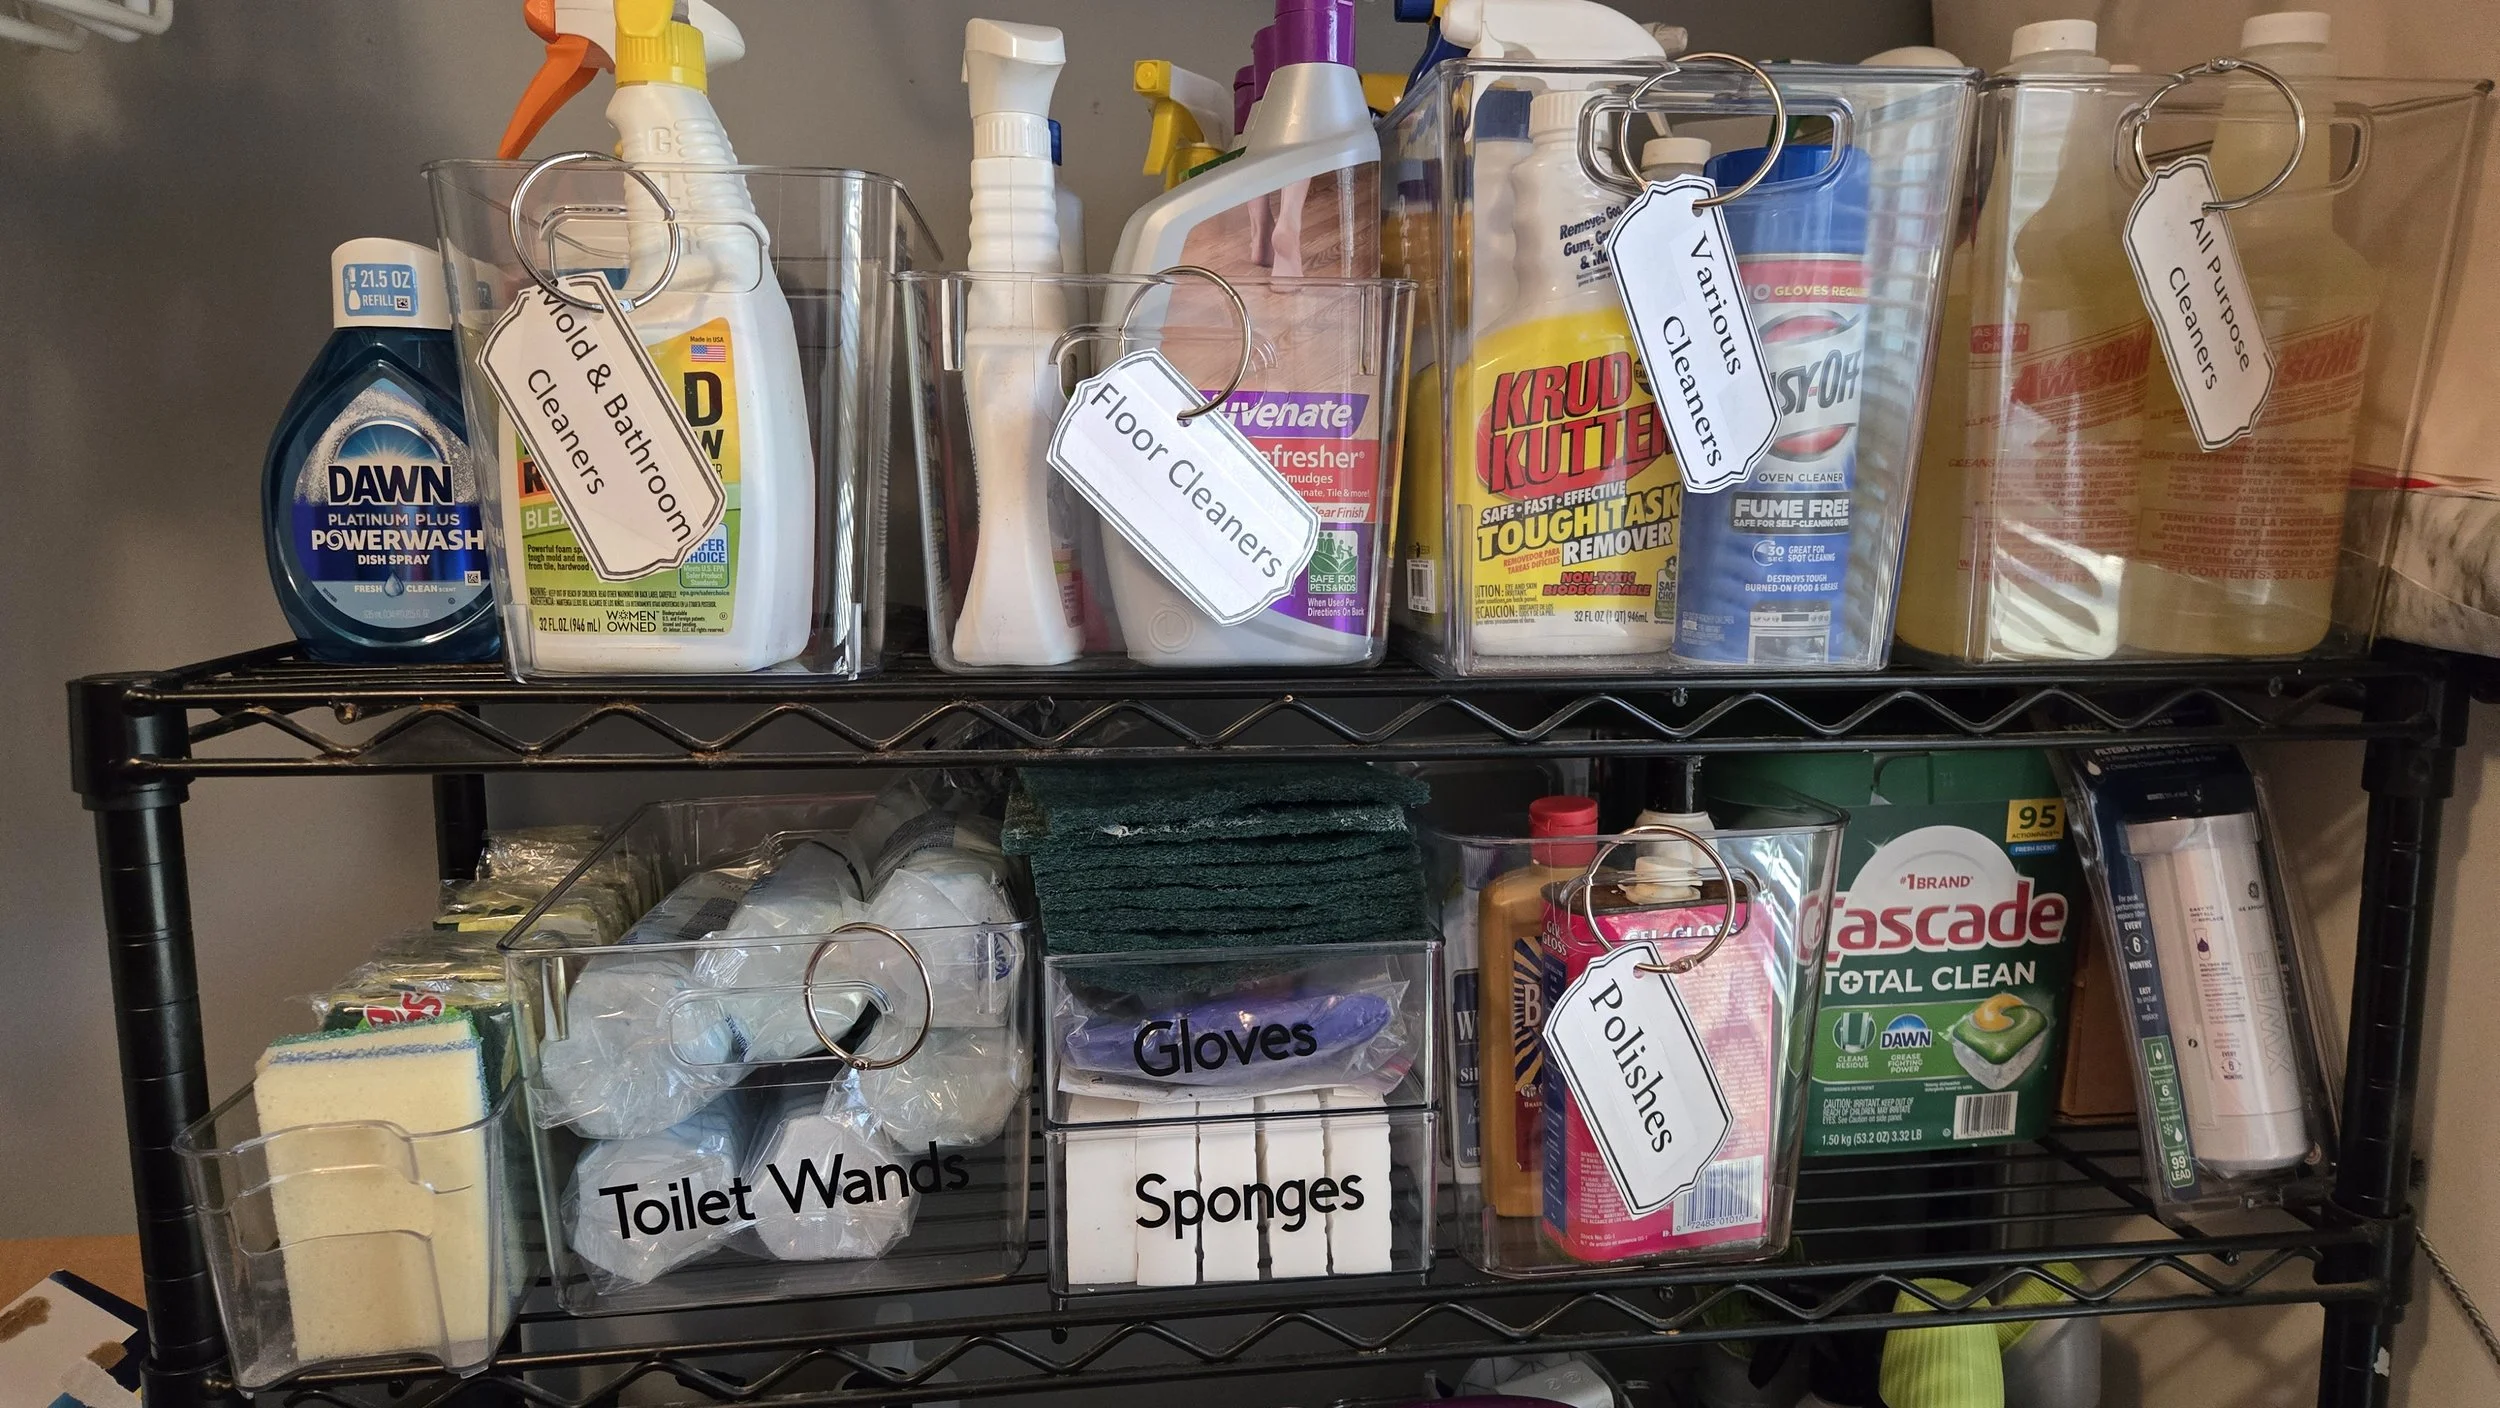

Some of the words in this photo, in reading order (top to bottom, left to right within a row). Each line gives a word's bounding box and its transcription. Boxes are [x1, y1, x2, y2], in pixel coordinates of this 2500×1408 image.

[1560, 213, 1606, 240] Removes
[1563, 240, 1594, 257] Gum,
[1580, 255, 1590, 270] &
[360, 270, 388, 288] 21.5
[392, 271, 411, 289] OZ
[1775, 286, 1829, 297] GLOVES
[2189, 217, 2215, 255] All
[2206, 255, 2250, 373] Purpose
[362, 294, 394, 307] REFILL
[1690, 231, 1741, 376] Various
[2169, 266, 2218, 390] Cleaners
[1492, 352, 1633, 432] KRUD
[1662, 315, 1722, 467] Cleaners
[537, 279, 598, 361] Mold
[586, 363, 611, 394] &
[604, 393, 692, 543] Bathroom
[1216, 399, 1352, 430] uvenate
[528, 369, 605, 495] Cleaners
[1090, 382, 1169, 462] Floor
[1168, 459, 1282, 578] Cleaners
[1758, 473, 1794, 483] OVEN
[1798, 473, 1844, 483] CLEANER
[328, 465, 455, 506] DAWN
[1327, 489, 1342, 497] Tile
[1343, 489, 1349, 497] &
[1350, 490, 1370, 498] more!
[1482, 505, 1515, 525] SAFE
[1524, 495, 1556, 516] FAST
[1563, 480, 1626, 507] EFFECTIVE
[1734, 499, 1804, 518] FUME
[1808, 499, 1849, 518] FREE
[1337, 506, 1365, 519] Finish
[328, 514, 409, 526] PLATINUM
[415, 513, 461, 526] PLUS
[1733, 519, 1756, 527] SAFE
[1757, 519, 1775, 528] FOR
[1776, 519, 1834, 528] SELF-CLEANING
[2240, 516, 2258, 526] DE
[2261, 516, 2277, 526] LA
[311, 529, 485, 551] POWERWASH
[1562, 520, 1673, 567] REMOVER
[527, 544, 554, 553] Powerful
[555, 545, 572, 553] foam
[1768, 546, 1785, 556] 30
[1788, 546, 1811, 554] GREAT
[1812, 546, 1825, 554] FOR
[2202, 546, 2232, 556] OUT
[2255, 548, 2298, 558] REACH
[358, 555, 386, 565] DISH
[388, 555, 431, 565] SPRAY
[528, 554, 545, 563] tough
[546, 554, 561, 562] mold
[563, 554, 575, 562] and
[1503, 551, 1545, 567] REMOVEDOR
[1545, 548, 1560, 558] PARA
[1787, 553, 1807, 562] SPOT
[1808, 552, 1836, 562] CLEANING
[528, 563, 542, 571] from
[557, 563, 590, 571] hardwood
[1507, 563, 1531, 575] TAREAS
[2188, 567, 2271, 580] CONTENTS:
[2273, 569, 2289, 579] 32
[1310, 574, 1335, 583] SAFE
[1338, 574, 1356, 583] FOR
[1561, 571, 1636, 584] NON-TOXIC
[1766, 574, 1805, 583] DESTROYS
[1806, 574, 1827, 582] TOUGH
[354, 585, 383, 593] FRESH
[406, 585, 438, 593] CLEAN
[1542, 584, 1652, 597] BIODEGRADABLE
[1745, 583, 1792, 592] BURNED-ON
[1793, 583, 1813, 592] FOOD
[1814, 583, 1819, 592] &
[1820, 582, 1839, 592] GREASE
[1307, 597, 1327, 607] When
[1328, 597, 1344, 607] Used
[1345, 597, 1356, 606] Per
[1307, 607, 1340, 617] Directions
[1342, 607, 1351, 617] On
[1351, 607, 1364, 617] Back
[1574, 611, 1583, 622] 32
[1585, 611, 1593, 622] FL
[1595, 611, 1605, 622] OZ
[1627, 611, 1649, 624] 946mL
[539, 617, 547, 631] 32
[607, 621, 657, 633] OWNED
[2018, 804, 2058, 830] 95
[2014, 845, 2035, 853] FRESH
[2036, 844, 2057, 852] SCENT
[2124, 921, 2142, 931] EVERY
[1542, 934, 1568, 956] GLOSS
[2132, 937, 2141, 953] 6
[2129, 960, 2152, 970] MONTHS
[1824, 969, 1923, 995] TOTAL
[1931, 960, 2036, 991] CLEAN
[2139, 987, 2151, 995] EASY
[1881, 1030, 1933, 1049] DAWN
[1133, 1019, 1317, 1077] Gloves
[1588, 978, 1672, 1154] Polishes
[1888, 1060, 1923, 1068] FIGHTING
[1890, 1066, 1920, 1074] POWER
[2228, 1061, 2235, 1071] 6
[2162, 1085, 2170, 1096] 6
[1823, 1098, 1852, 1108] CAUTION:
[1822, 1135, 1840, 1145] 1.50
[1841, 1133, 1852, 1146] kg
[1853, 1132, 1876, 1145] (53.2
[1877, 1131, 1890, 1144] OZ)
[1892, 1131, 1910, 1142] 3.32
[1911, 1130, 1922, 1141] LB
[2171, 1170, 2191, 1182] LEAD
[599, 1176, 756, 1240] Toilet
[767, 1140, 970, 1215] Wands
[1136, 1173, 1365, 1240] Sponges
[1691, 1220, 1716, 1229] 72483
[1719, 1216, 1745, 1225] 01010
